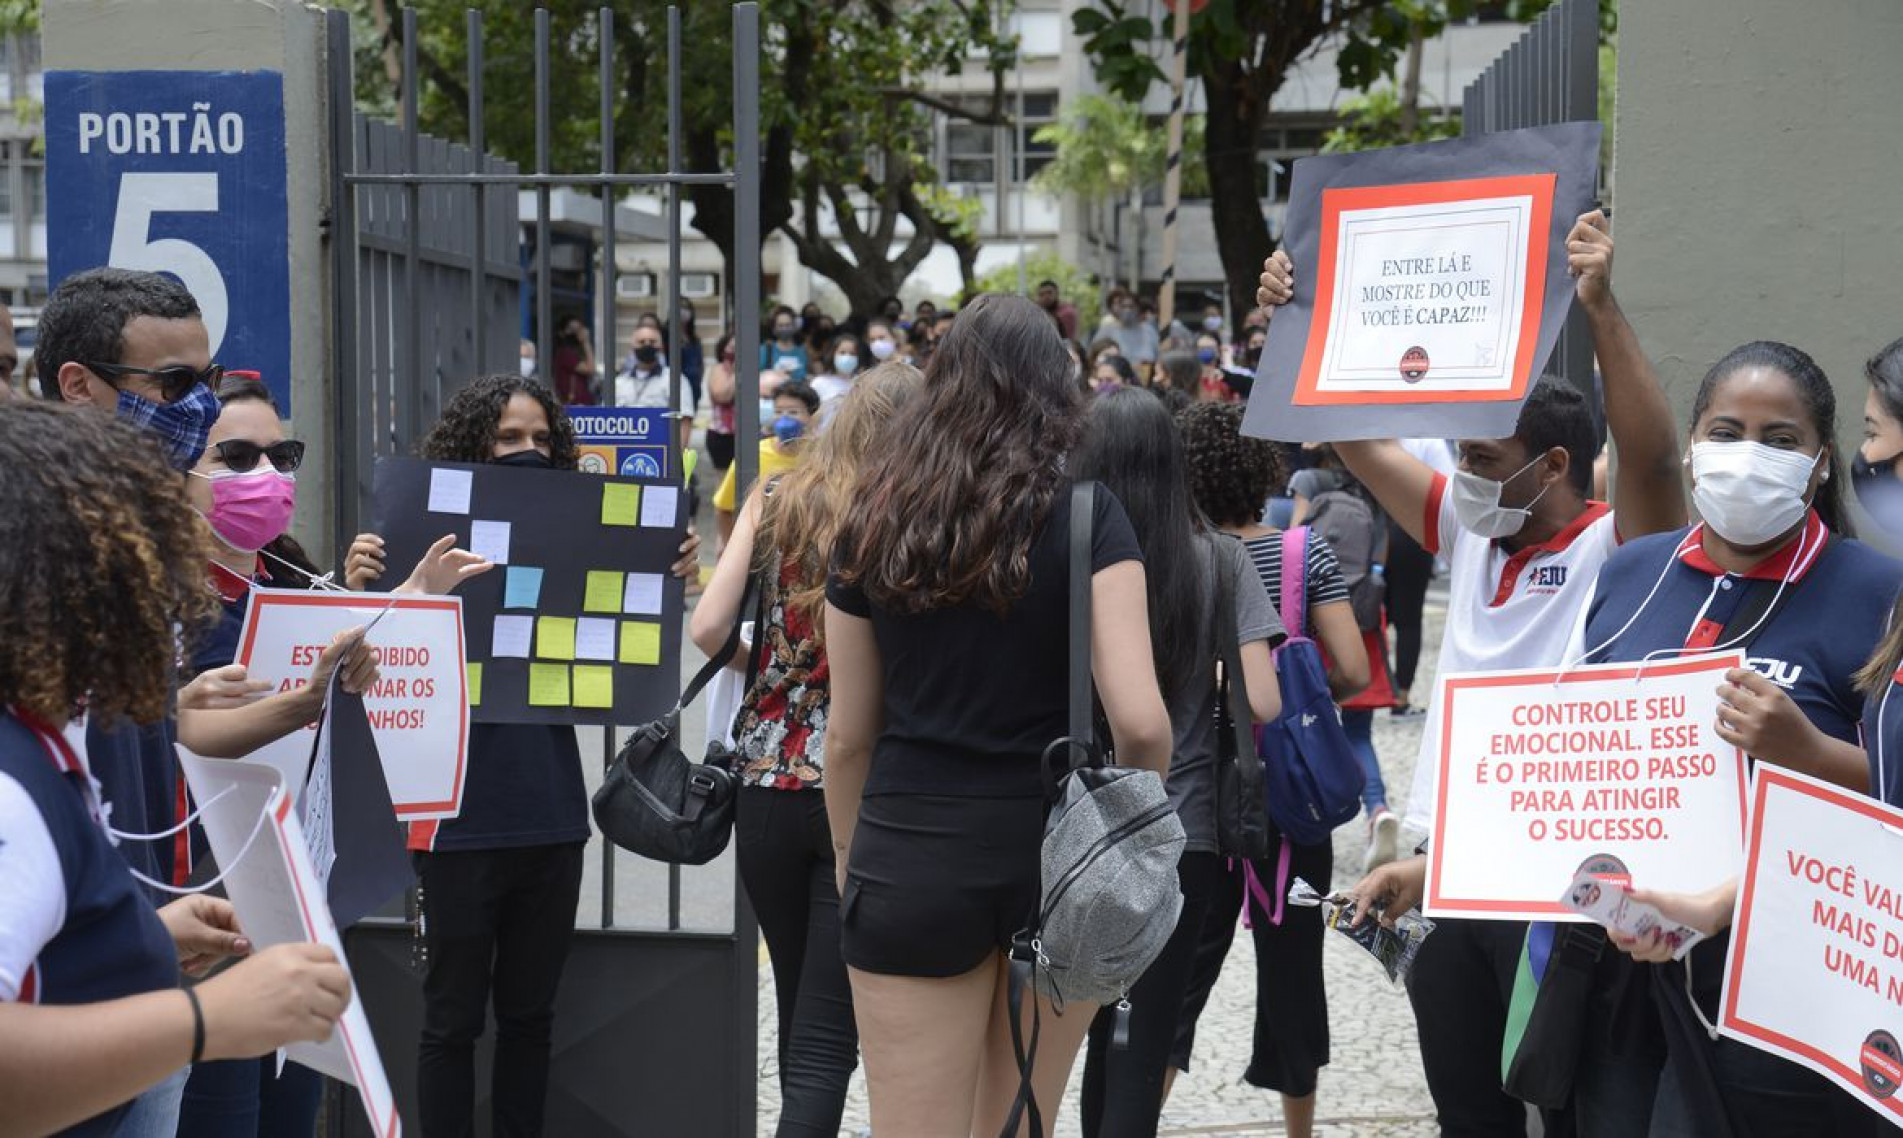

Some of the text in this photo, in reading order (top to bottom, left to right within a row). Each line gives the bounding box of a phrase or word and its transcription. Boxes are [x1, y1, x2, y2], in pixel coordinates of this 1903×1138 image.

[79, 102, 244, 154] PORTÃO
[108, 171, 229, 361] 5
[1382, 251, 1472, 277] ENTRE LÁ E
[1362, 279, 1491, 303] MOSTRE DO QUE
[1361, 304, 1487, 327] VOCÊ É CAPAZ!!!
[569, 416, 650, 435] OTOCOLO
[291, 645, 430, 666] EST OIBIDO
[412, 677, 435, 698] OS
[1511, 695, 1686, 726] CONTROLE SEU
[1490, 724, 1699, 755] EMOCIONAL. ESSE
[1476, 753, 1717, 784] É O PRIMEIRO PASSO
[1510, 786, 1681, 812] PARA ATINGIR
[1528, 817, 1669, 841] O SUCESSO.
[1787, 849, 1903, 921] VOCÊ VAL
[1812, 899, 1877, 949] MAIS
[1824, 944, 1880, 994] UMA
